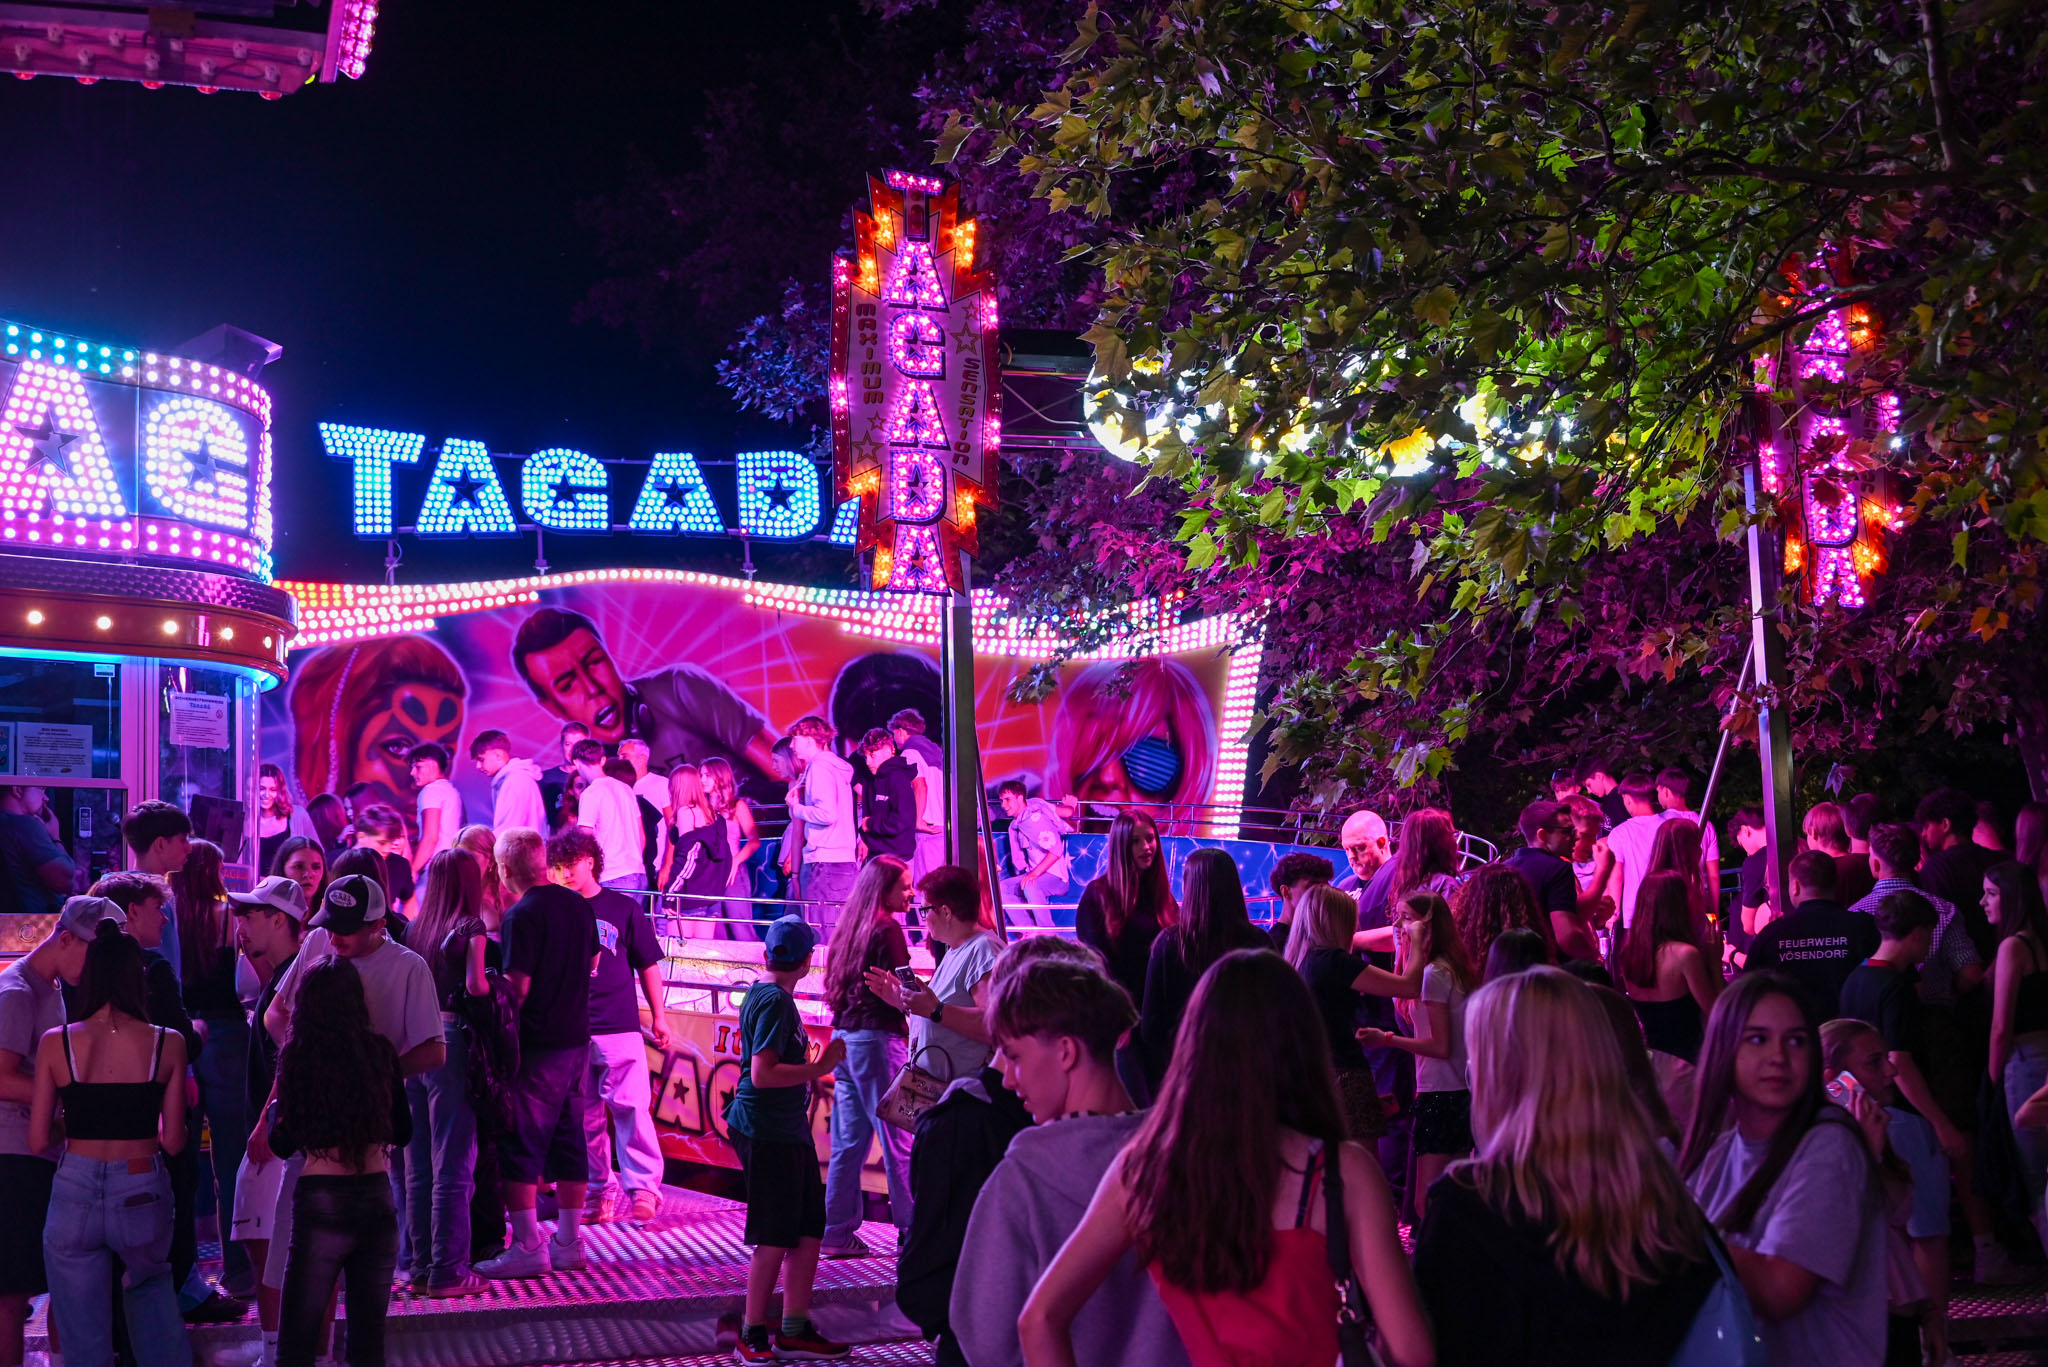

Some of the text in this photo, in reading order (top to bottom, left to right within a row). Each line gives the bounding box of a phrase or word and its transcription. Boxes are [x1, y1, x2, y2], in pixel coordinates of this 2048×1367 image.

[856, 303, 884, 404] MAXIMUM
[883, 168, 951, 597] TAGADA
[952, 357, 980, 466] SENSATION
[318, 421, 859, 541] TAGAD
[1778, 936, 1847, 949] FEUERWEHR
[1779, 949, 1848, 962] VÖSENDORF
